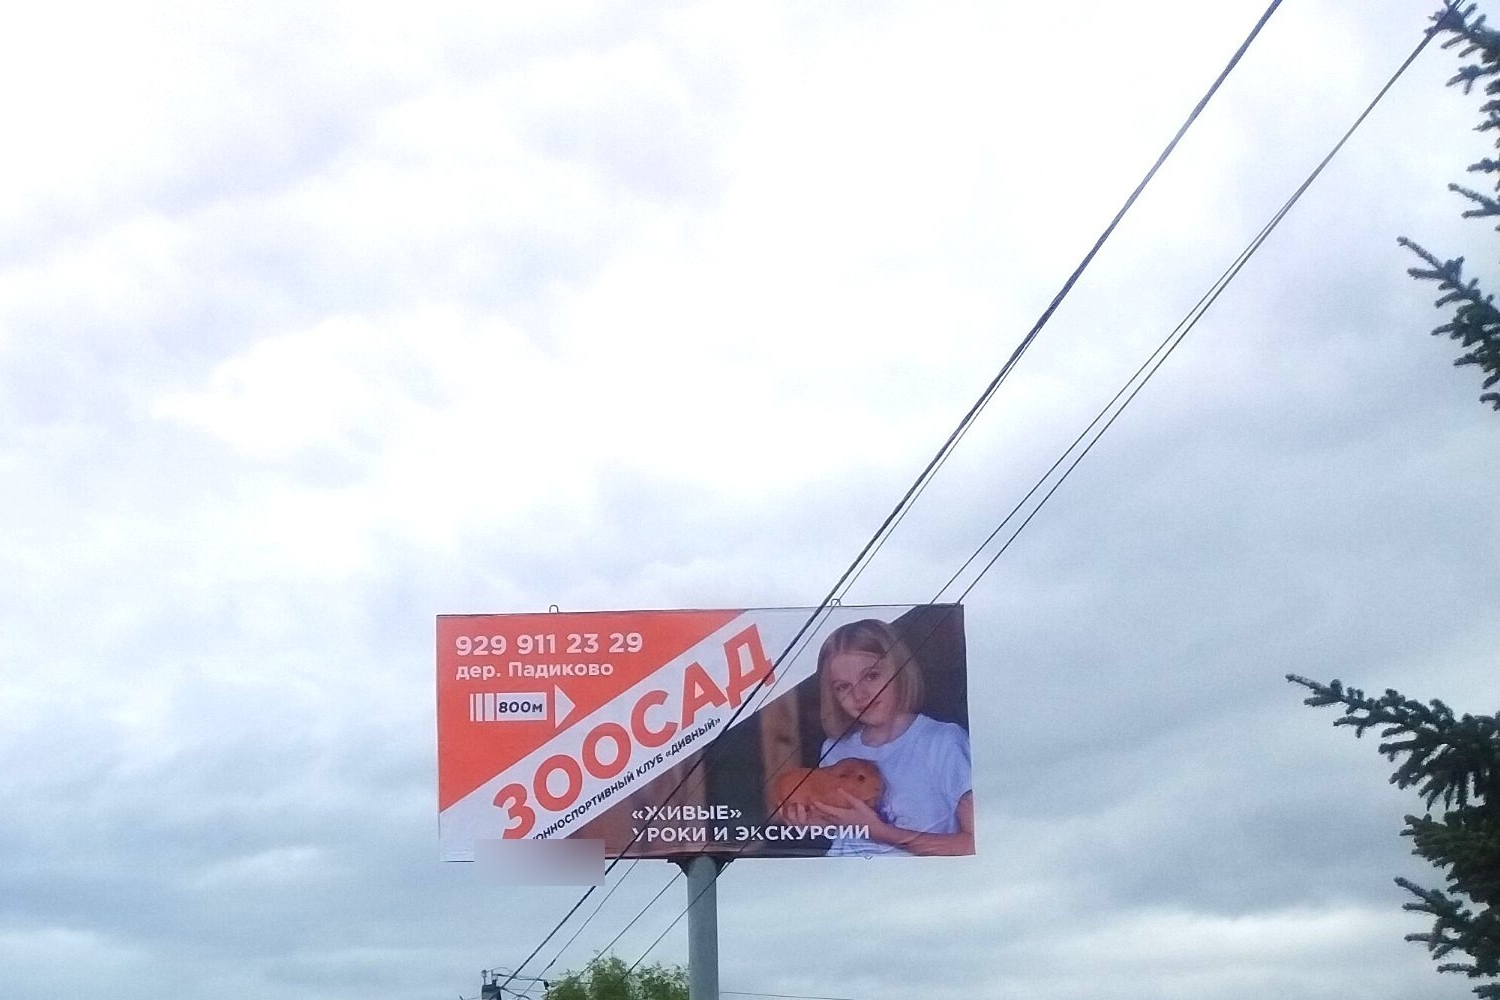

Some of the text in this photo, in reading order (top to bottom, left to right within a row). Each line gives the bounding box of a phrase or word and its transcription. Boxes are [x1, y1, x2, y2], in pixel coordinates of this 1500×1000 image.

[455, 632, 643, 656] 929 911 23 29
[455, 661, 614, 681] дер. Падиково
[498, 700, 543, 714] 800м
[492, 622, 777, 840] ЗООСАД
[531, 770, 635, 840] ОННОСПОРТИВНЫЙ
[635, 754, 664, 778] КЛУБ
[631, 805, 742, 821] «ЖИВЫЕ»
[631, 824, 870, 842] УРОКИ И ЭКСКУРСИИ
